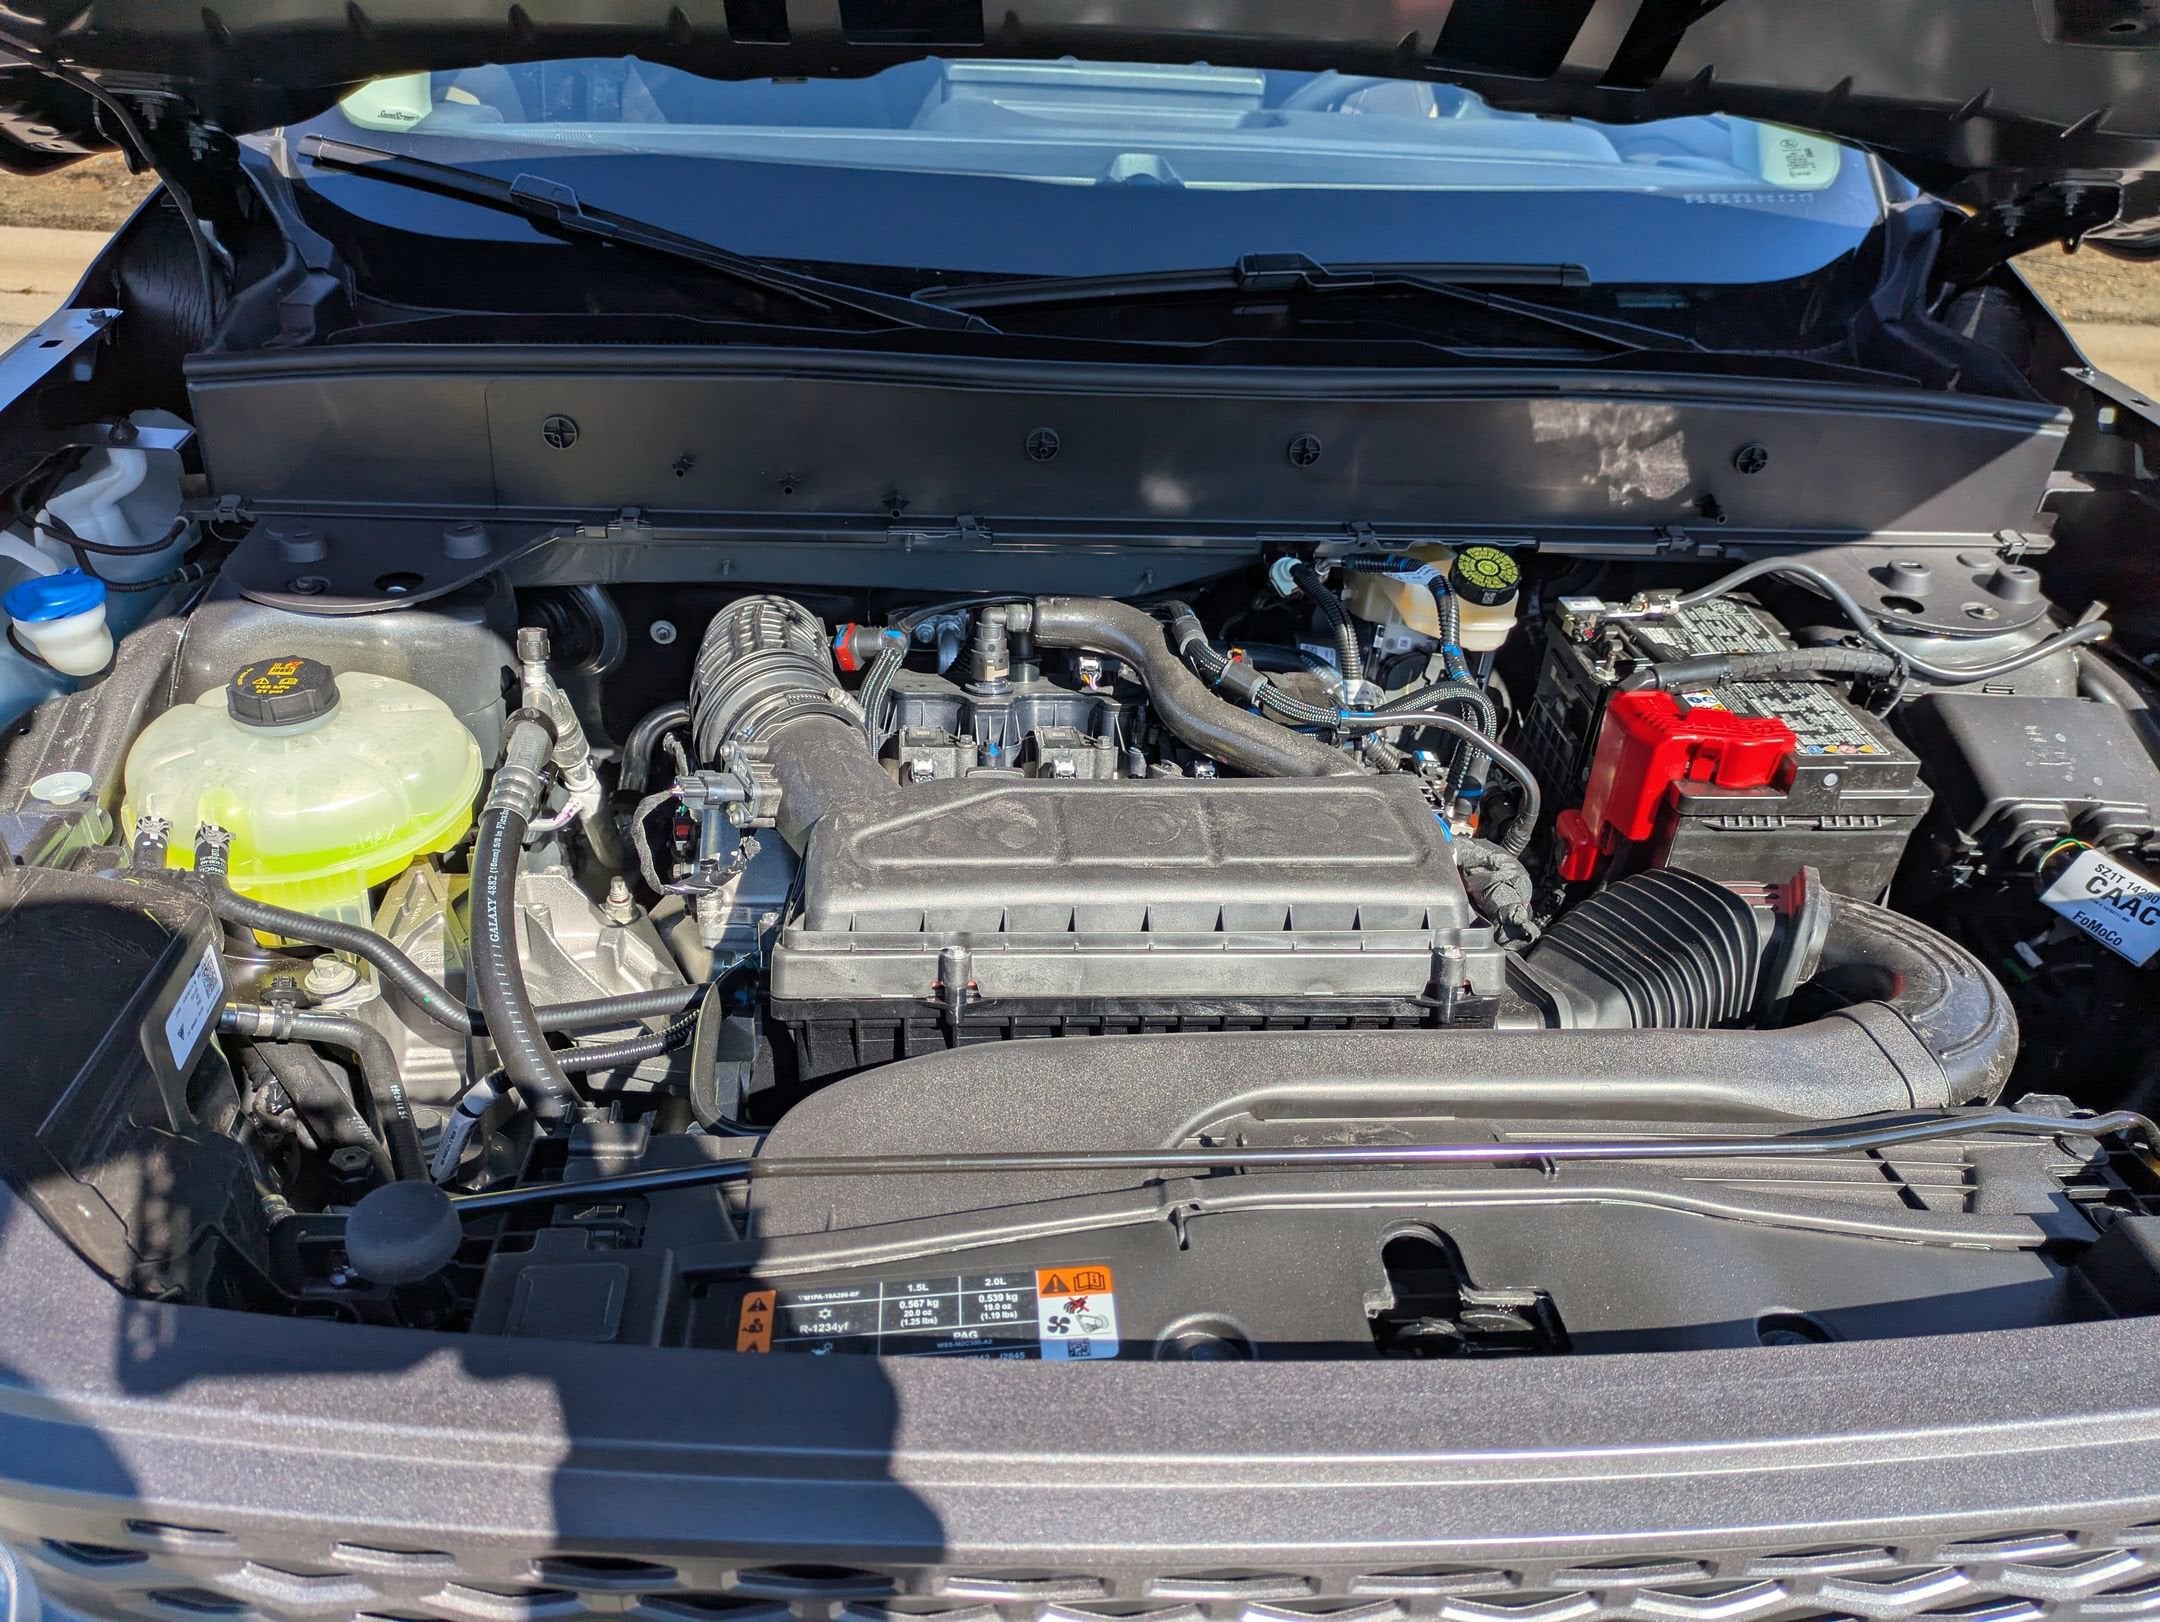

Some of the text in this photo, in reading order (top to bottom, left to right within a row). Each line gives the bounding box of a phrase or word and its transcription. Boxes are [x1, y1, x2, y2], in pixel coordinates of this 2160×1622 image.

[488, 875, 498, 896] 4882
[2094, 863, 2160, 904] SZ1T 14290
[2085, 875, 2160, 926] CAAC
[488, 898, 499, 942] GALAXY
[2072, 910, 2123, 946] FoMoCo
[907, 1283, 929, 1292] 1.5L
[984, 1277, 1007, 1287] 2.0L
[899, 1298, 939, 1310] 0.567 kg
[978, 1292, 1018, 1304] 0.539 kg
[903, 1309, 932, 1318] 20.0 oz
[983, 1303, 1012, 1312] 19.0 oz
[900, 1316, 938, 1328] (1.25 lbs)
[980, 1310, 1018, 1322] (1.19 lbs)
[800, 1321, 849, 1334] R-1234yf
[953, 1330, 979, 1341] PAG
